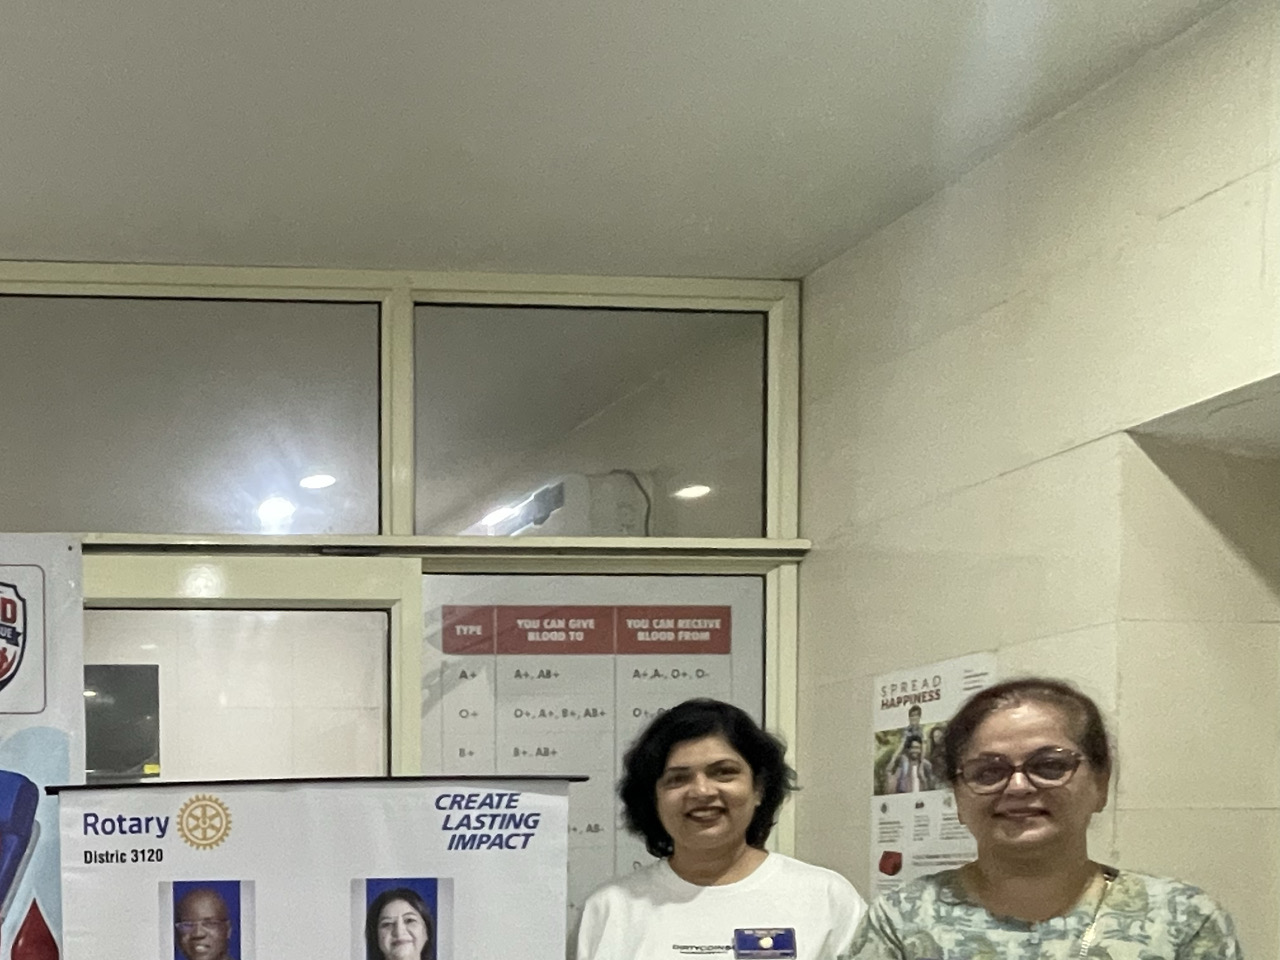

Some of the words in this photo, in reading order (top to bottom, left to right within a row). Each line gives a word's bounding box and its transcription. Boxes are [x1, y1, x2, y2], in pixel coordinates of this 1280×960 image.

[455, 625, 482, 636] TYPE
[517, 618, 540, 629] YOU
[543, 618, 566, 629] CAN
[569, 618, 595, 629] GIVE
[626, 618, 649, 629] YOU
[569, 631, 584, 641] TO
[459, 669, 477, 680] A+
[881, 675, 942, 697] SPREAD
[881, 689, 941, 710] HAPPINESS
[458, 708, 478, 719] O+
[434, 793, 521, 811] CREATE
[83, 813, 170, 839] Rotary
[442, 813, 541, 831] LASTING
[447, 833, 535, 850] IMPACT
[83, 850, 127, 864] Distric
[130, 848, 164, 863] 3120
